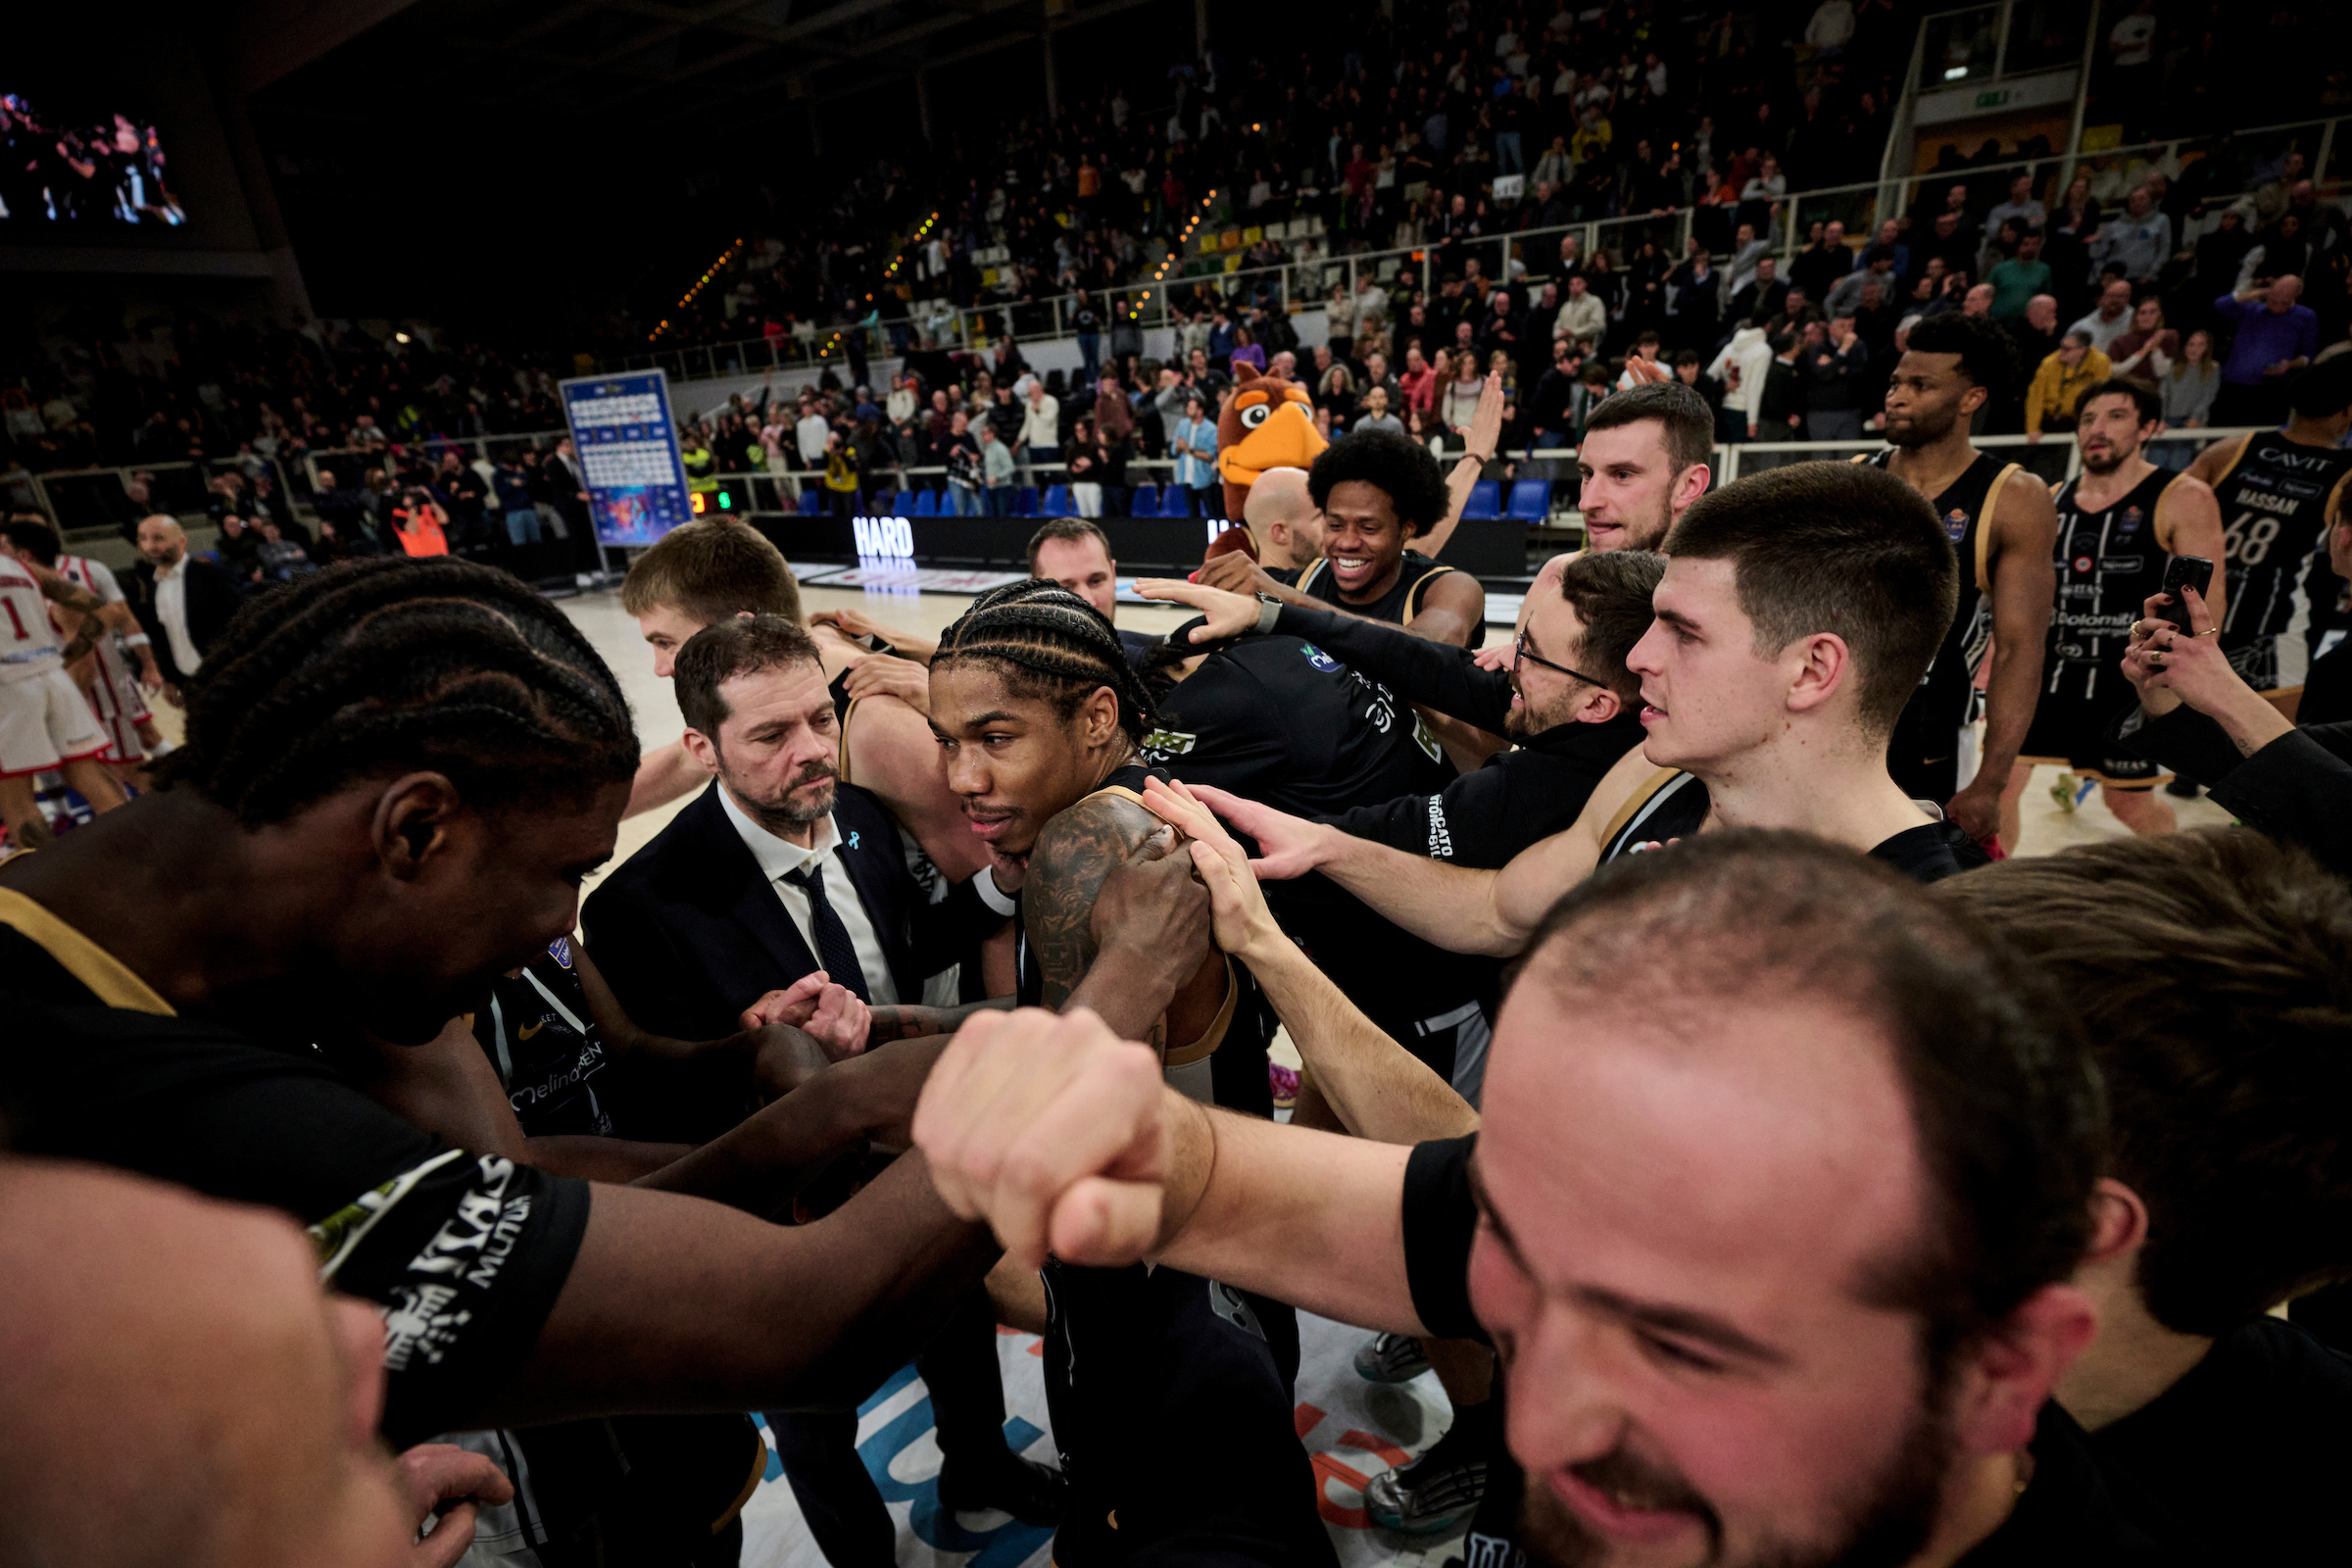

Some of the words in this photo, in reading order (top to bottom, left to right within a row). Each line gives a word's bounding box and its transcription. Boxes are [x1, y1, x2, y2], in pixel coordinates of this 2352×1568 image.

[2258, 446, 2334, 472] CAVIT
[2234, 487, 2300, 516] HASSAN
[853, 515, 914, 558] HARD
[2226, 511, 2281, 566] 68
